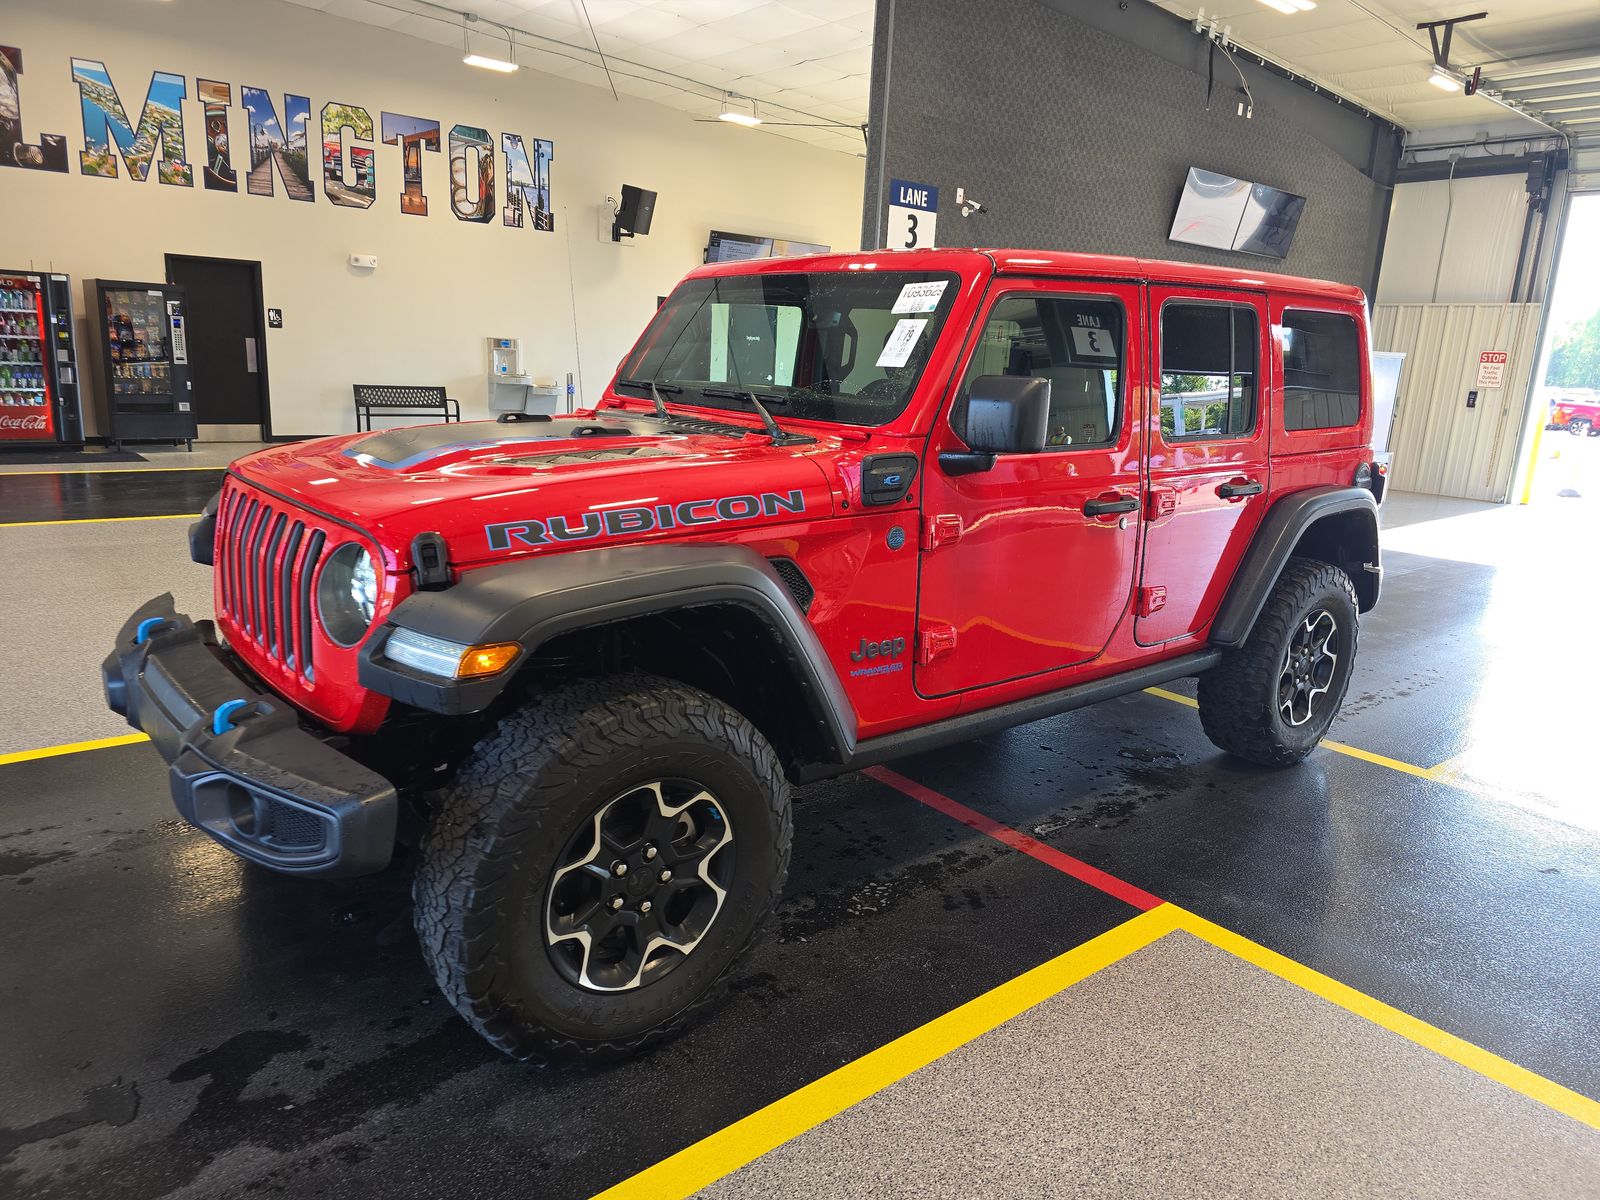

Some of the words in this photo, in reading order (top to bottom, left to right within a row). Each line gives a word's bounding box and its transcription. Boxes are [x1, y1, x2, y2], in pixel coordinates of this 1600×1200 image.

[900, 186, 928, 207] LANE
[904, 213, 918, 249] 3
[1482, 354, 1506, 362] STOP
[484, 489, 806, 551] RUBICON
[851, 637, 905, 662] Jeep
